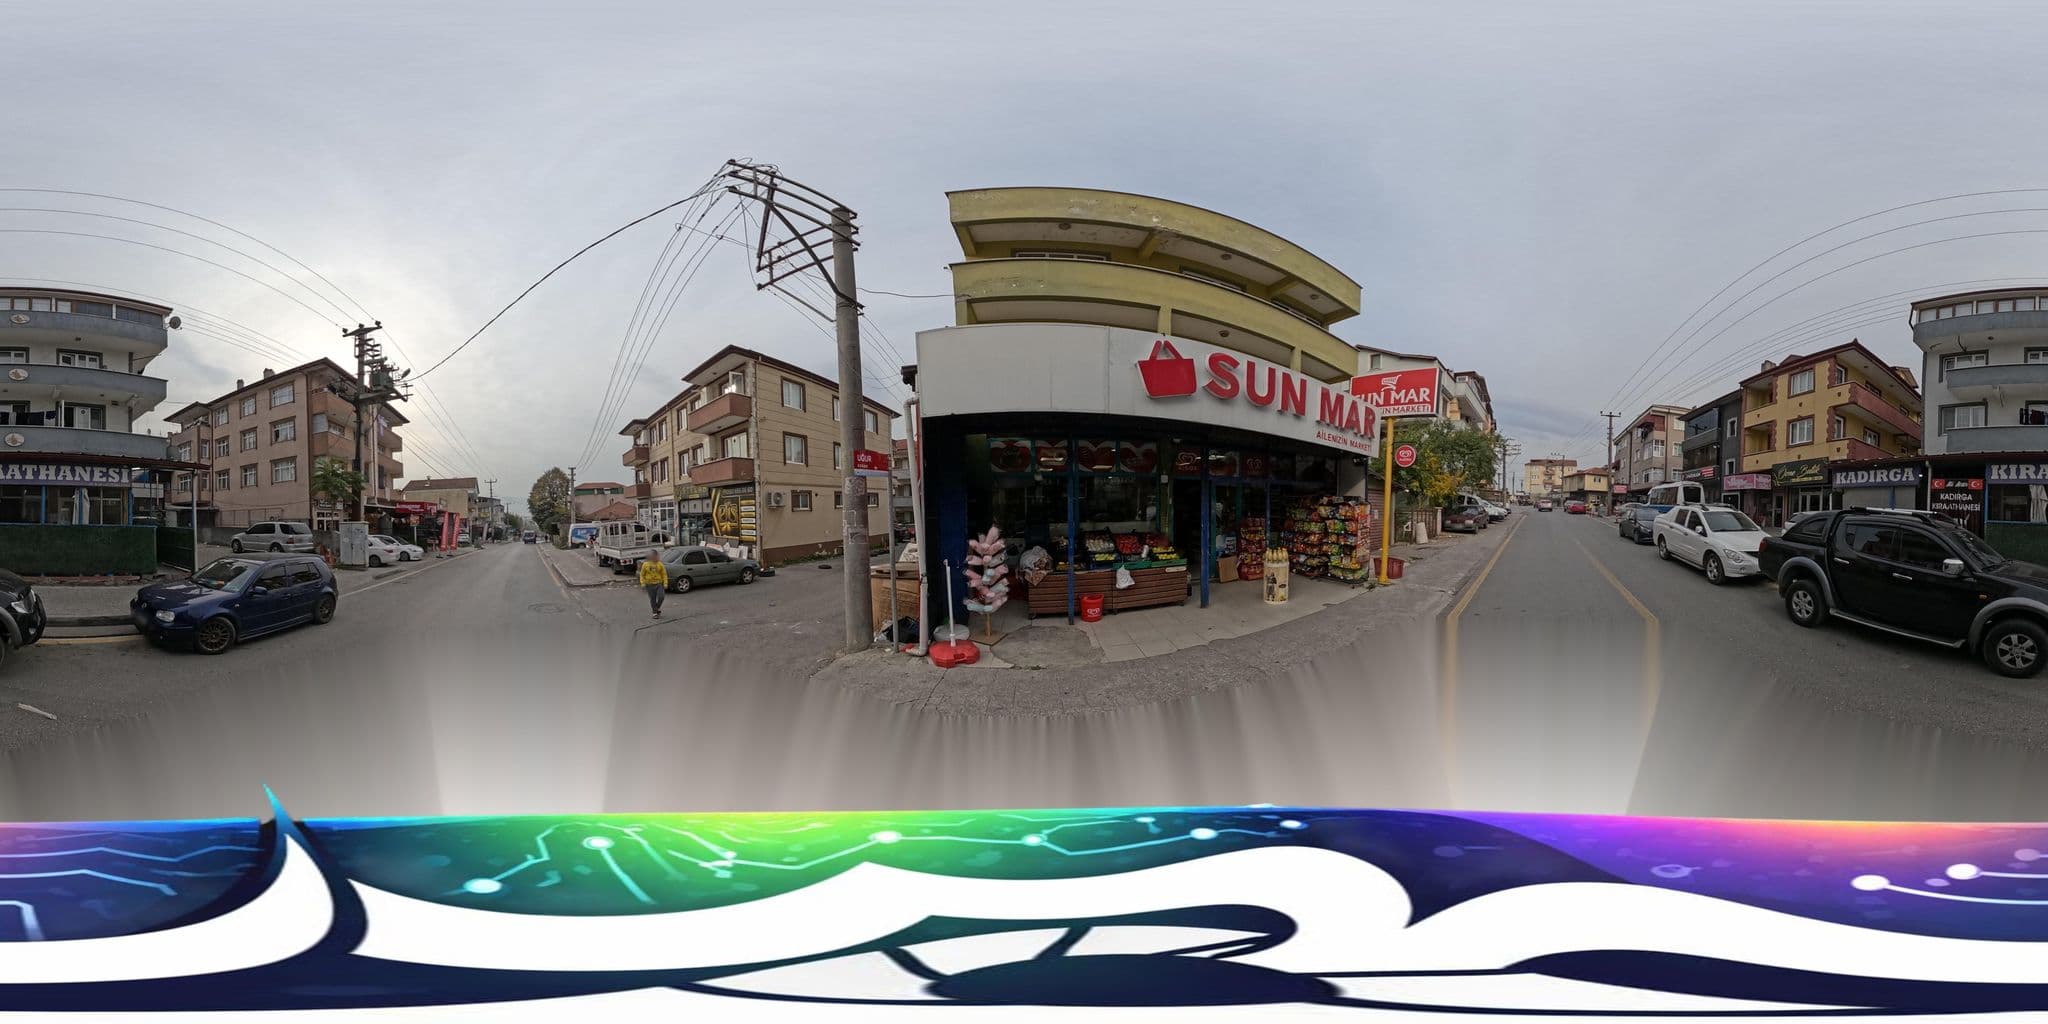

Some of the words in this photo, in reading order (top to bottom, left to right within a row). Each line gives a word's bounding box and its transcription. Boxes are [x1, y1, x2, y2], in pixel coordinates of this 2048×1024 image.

[1202, 352, 1308, 417] SUN
[1319, 385, 1377, 439] MAR
[1356, 392, 1384, 406] UN
[1390, 387, 1431, 405] MAR
[1835, 468, 1915, 484] KADIRGA
[1940, 492, 1973, 501] KADIRGA
